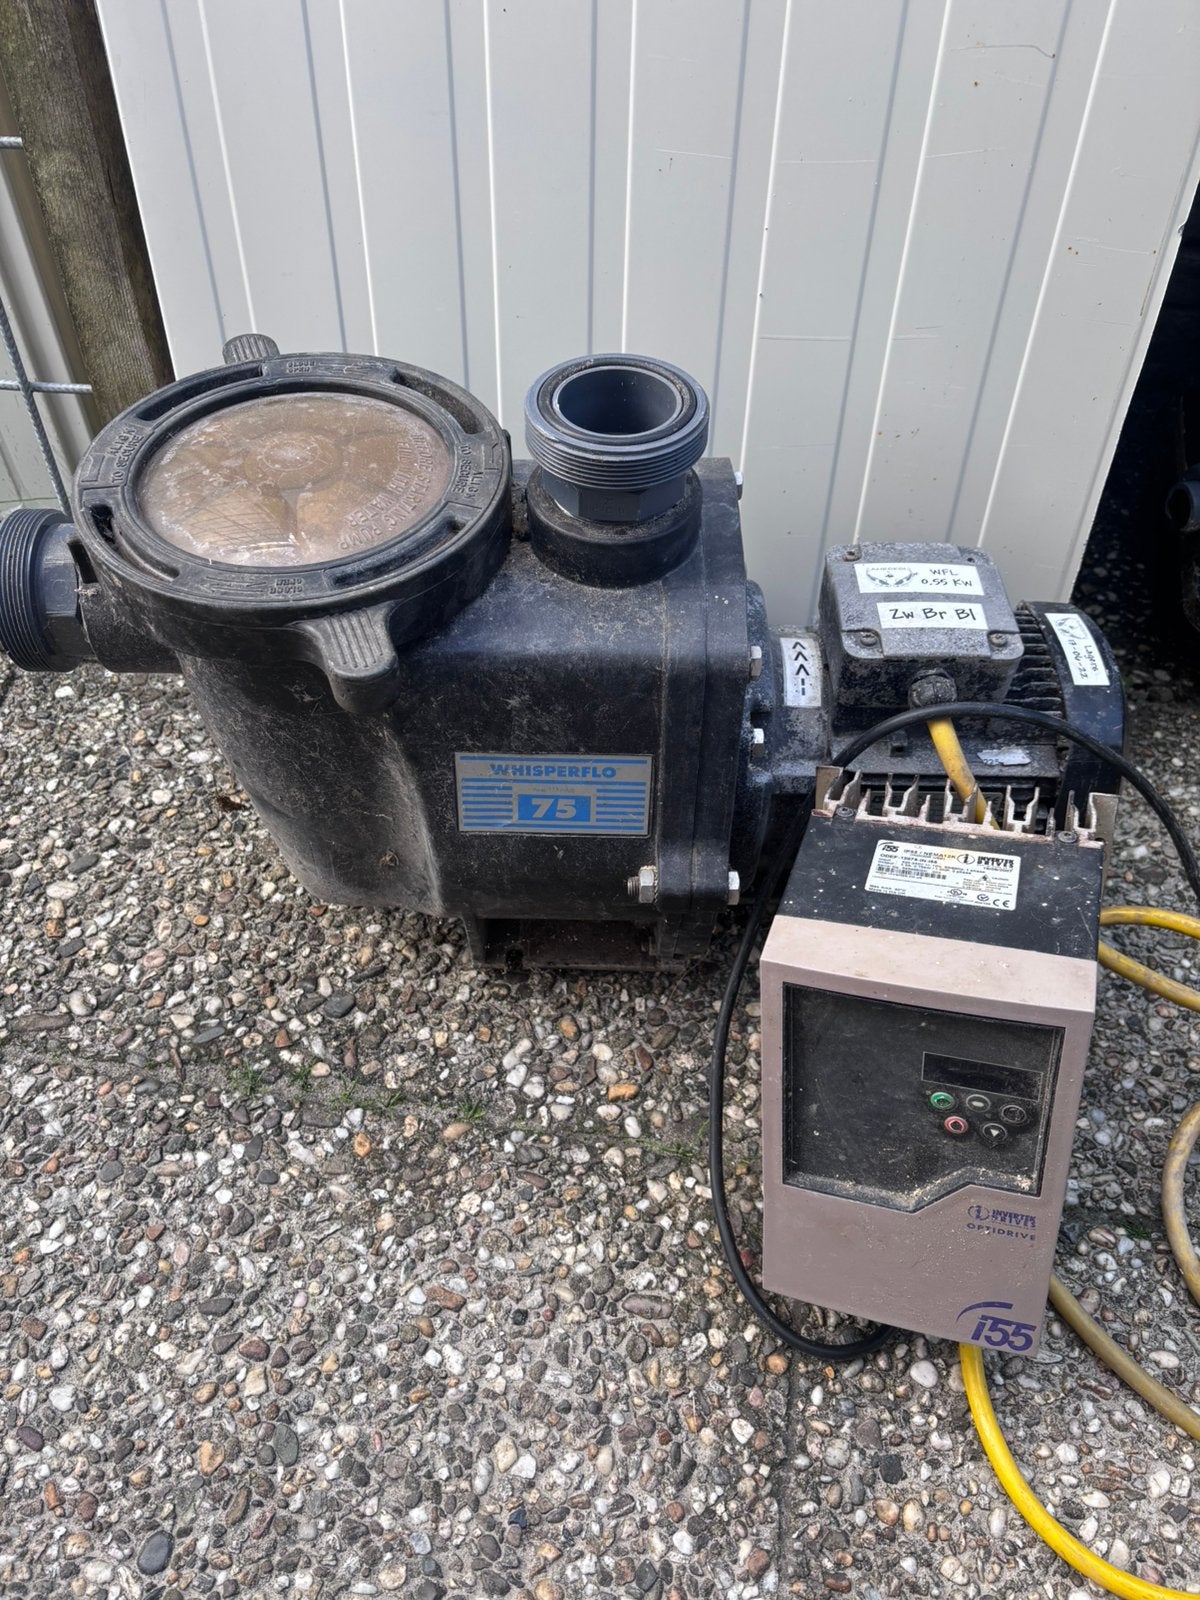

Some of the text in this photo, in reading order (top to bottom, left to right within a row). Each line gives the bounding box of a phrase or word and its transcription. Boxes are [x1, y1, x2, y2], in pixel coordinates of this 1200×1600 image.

[109, 429, 135, 457] ALIGN
[111, 435, 144, 484] TO SECURE
[452, 459, 472, 494] SECURE
[463, 470, 484, 500] ALIGN
[345, 493, 397, 528] WATER
[336, 524, 384, 551] PUMP
[921, 578, 948, 586] 0.55
[889, 609, 914, 620] Zw
[923, 608, 947, 620] Br
[489, 763, 617, 779] WHISPERFLO
[531, 798, 577, 819] 75
[992, 1209, 1036, 1221] INVERTEK
[992, 1216, 1036, 1228] DRIVES
[967, 1223, 1036, 1241] OPTIDRIVE
[971, 1315, 1037, 1351] i55
